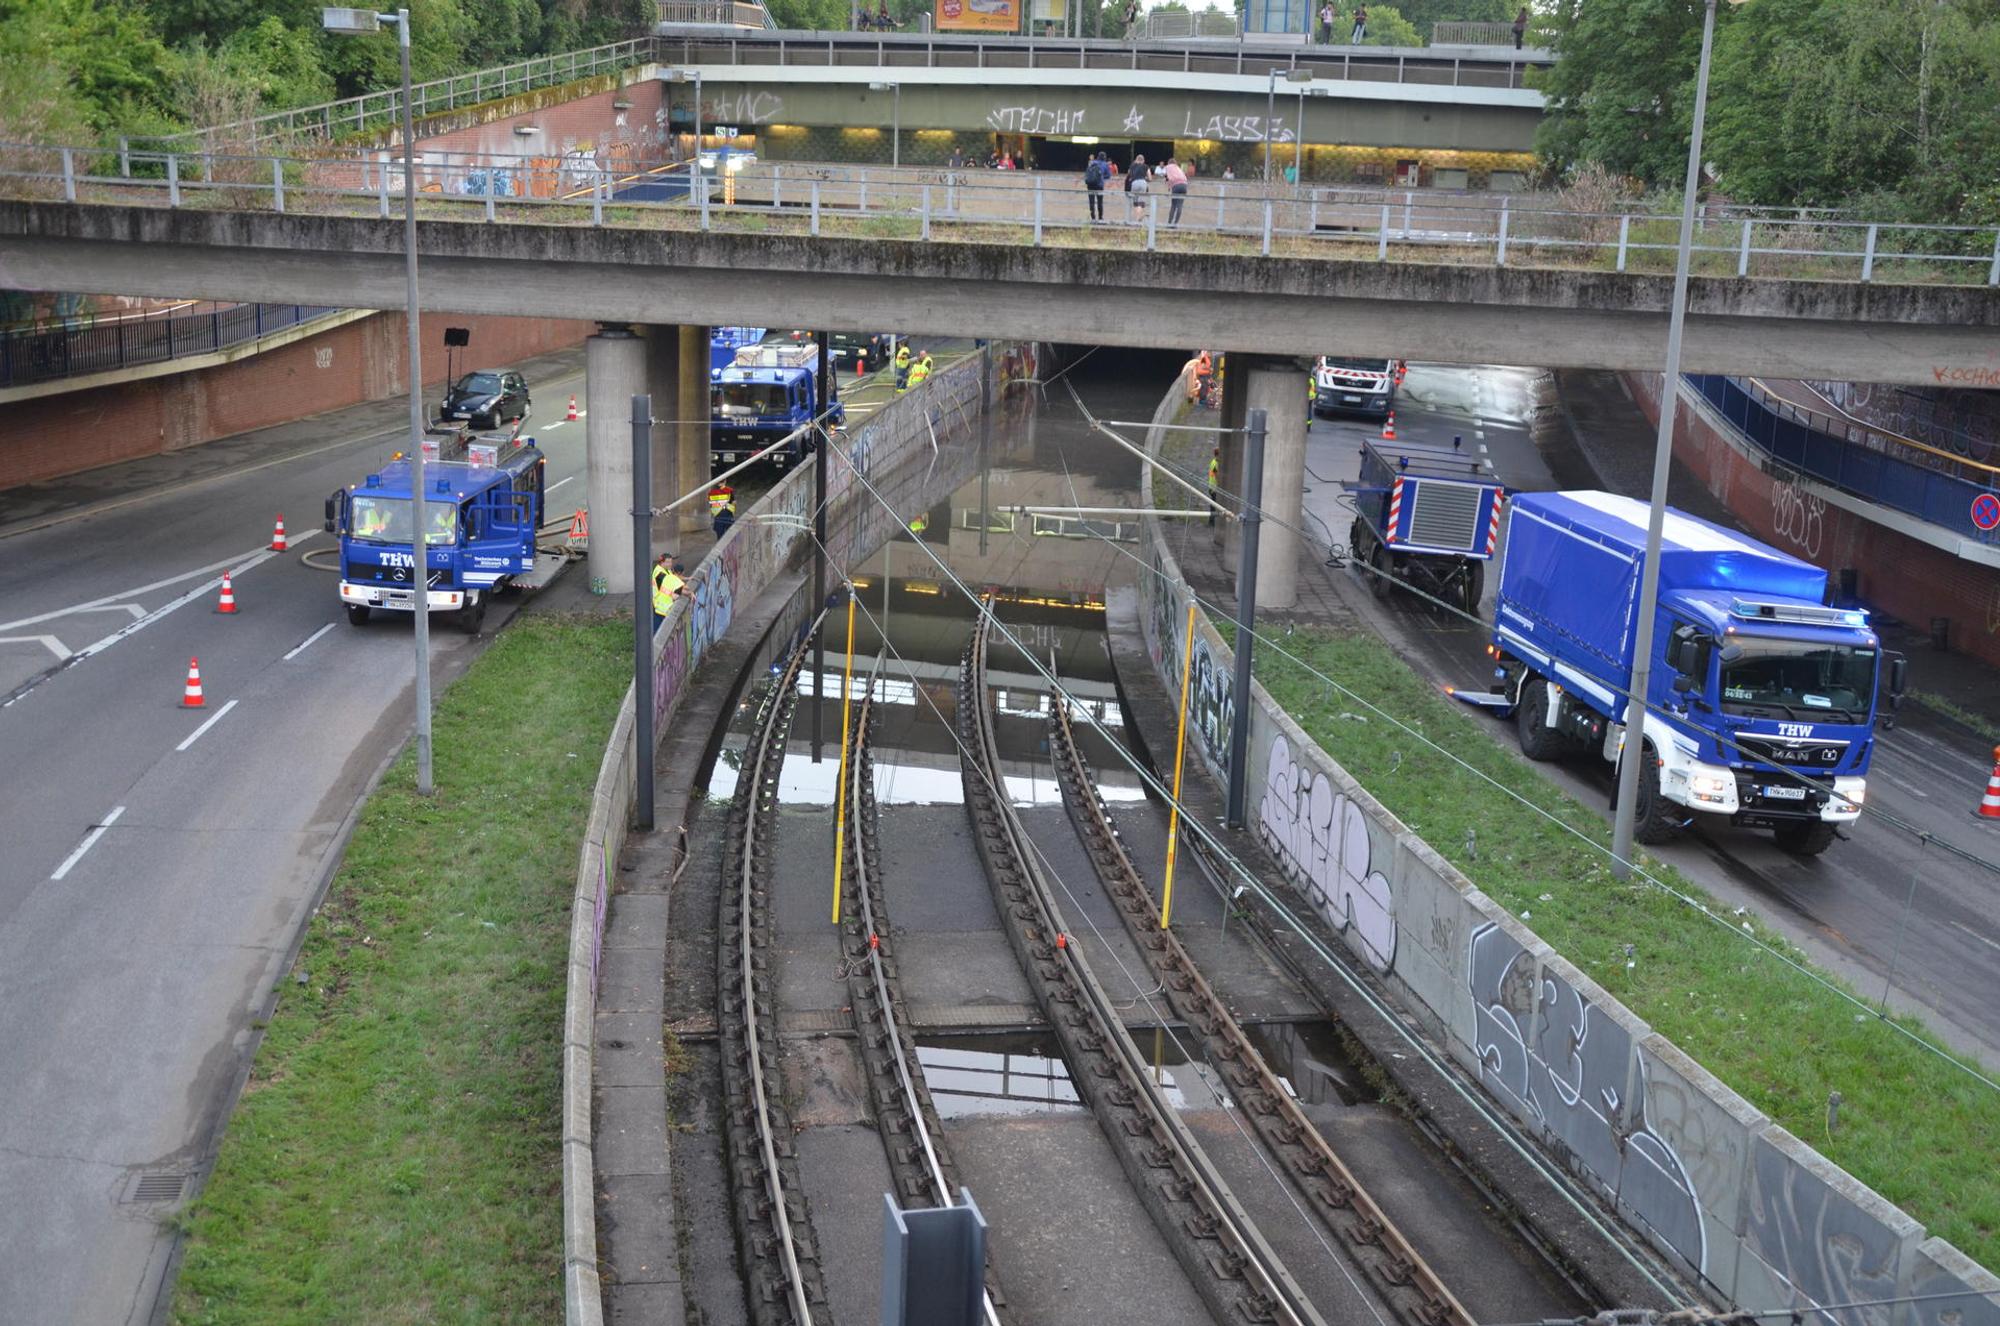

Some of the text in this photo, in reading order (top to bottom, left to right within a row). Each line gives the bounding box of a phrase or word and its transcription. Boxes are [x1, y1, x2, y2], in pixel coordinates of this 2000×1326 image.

[379, 552, 415, 568] THW
[1778, 723, 1814, 738] THW
[1772, 750, 1809, 761] MAN
